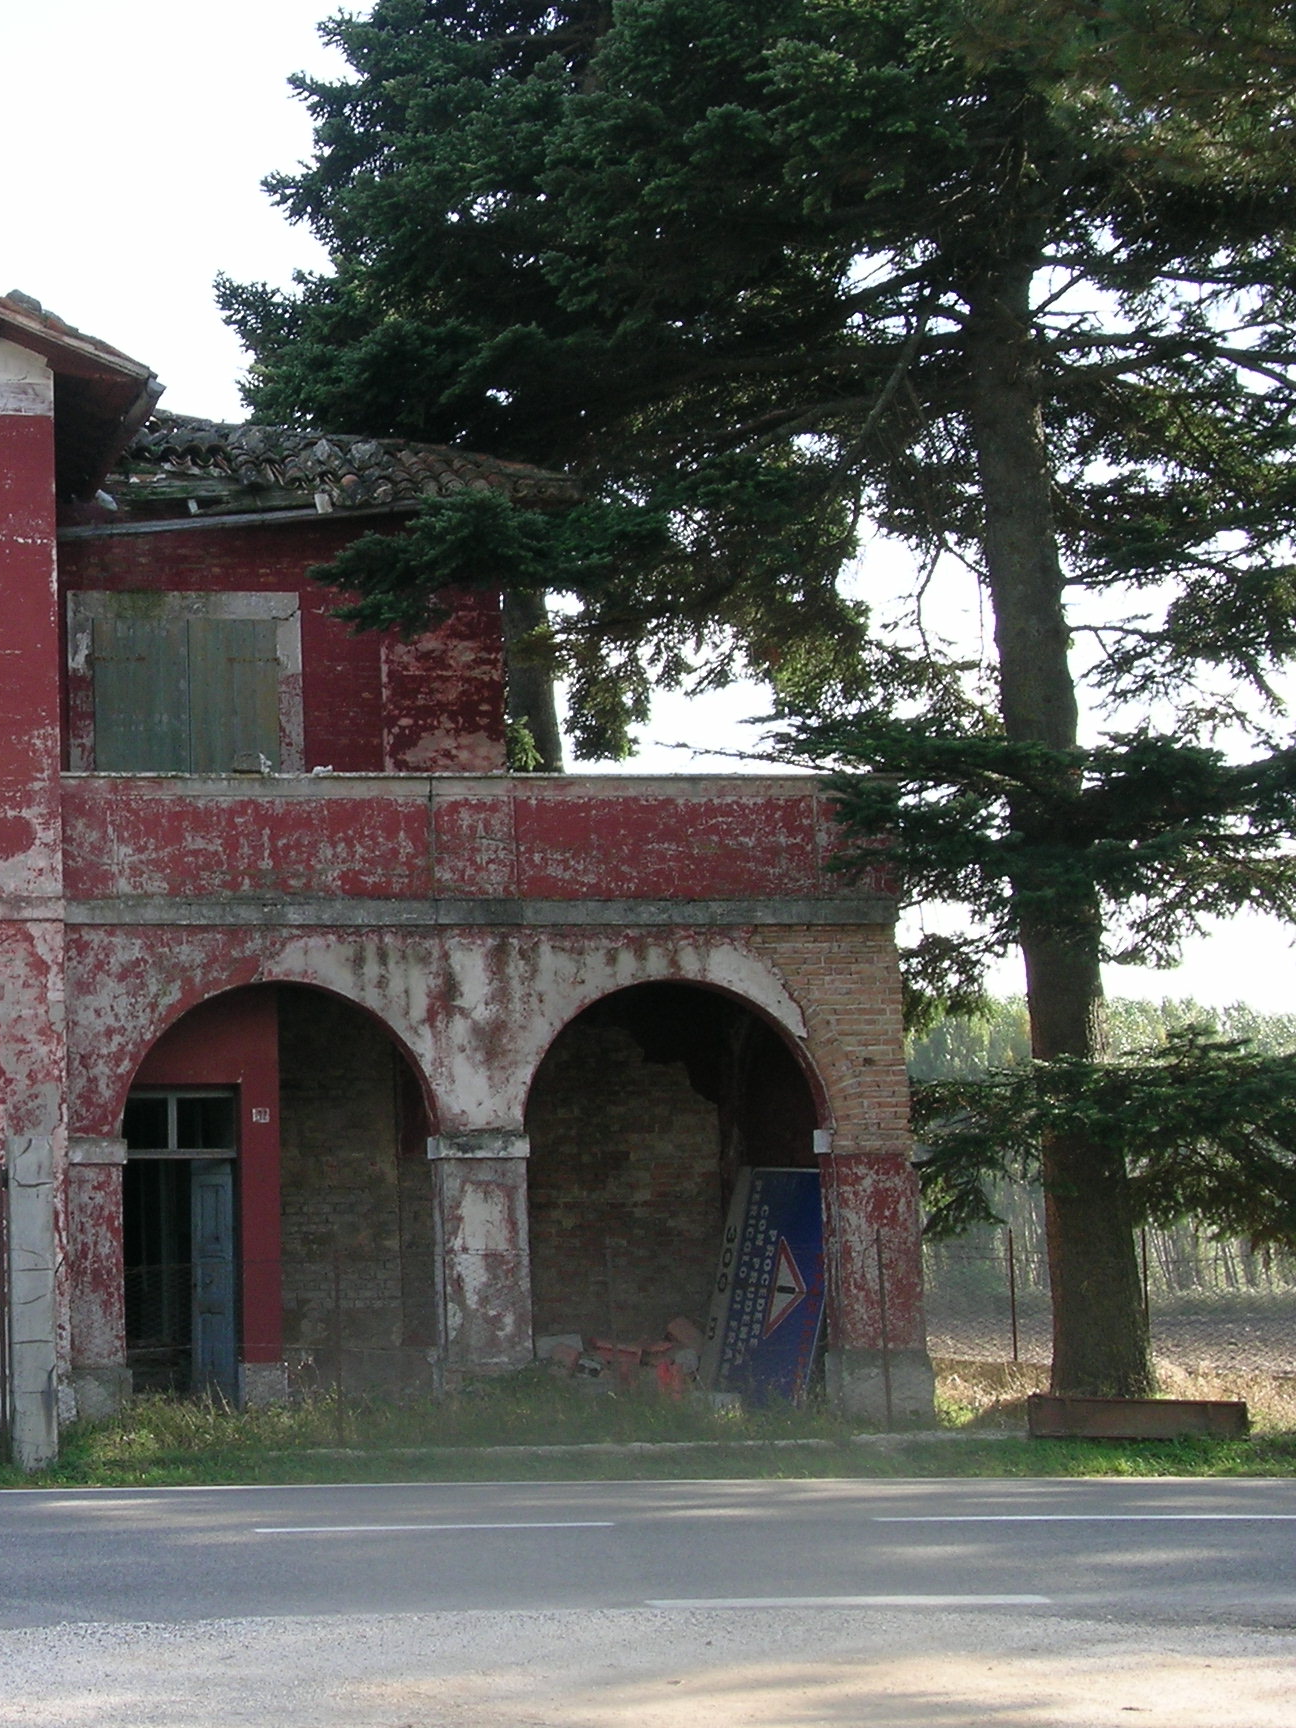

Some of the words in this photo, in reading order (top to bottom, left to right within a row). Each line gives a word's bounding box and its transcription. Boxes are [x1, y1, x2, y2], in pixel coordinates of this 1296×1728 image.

[717, 1225, 738, 1293] 300
[739, 1179, 763, 1279] PERICOLO
[755, 1204, 770, 1247] CON
[733, 1289, 743, 1310] DI
[734, 1256, 760, 1366] PRUDENZA
[750, 1229, 778, 1348] PROCEDERE
